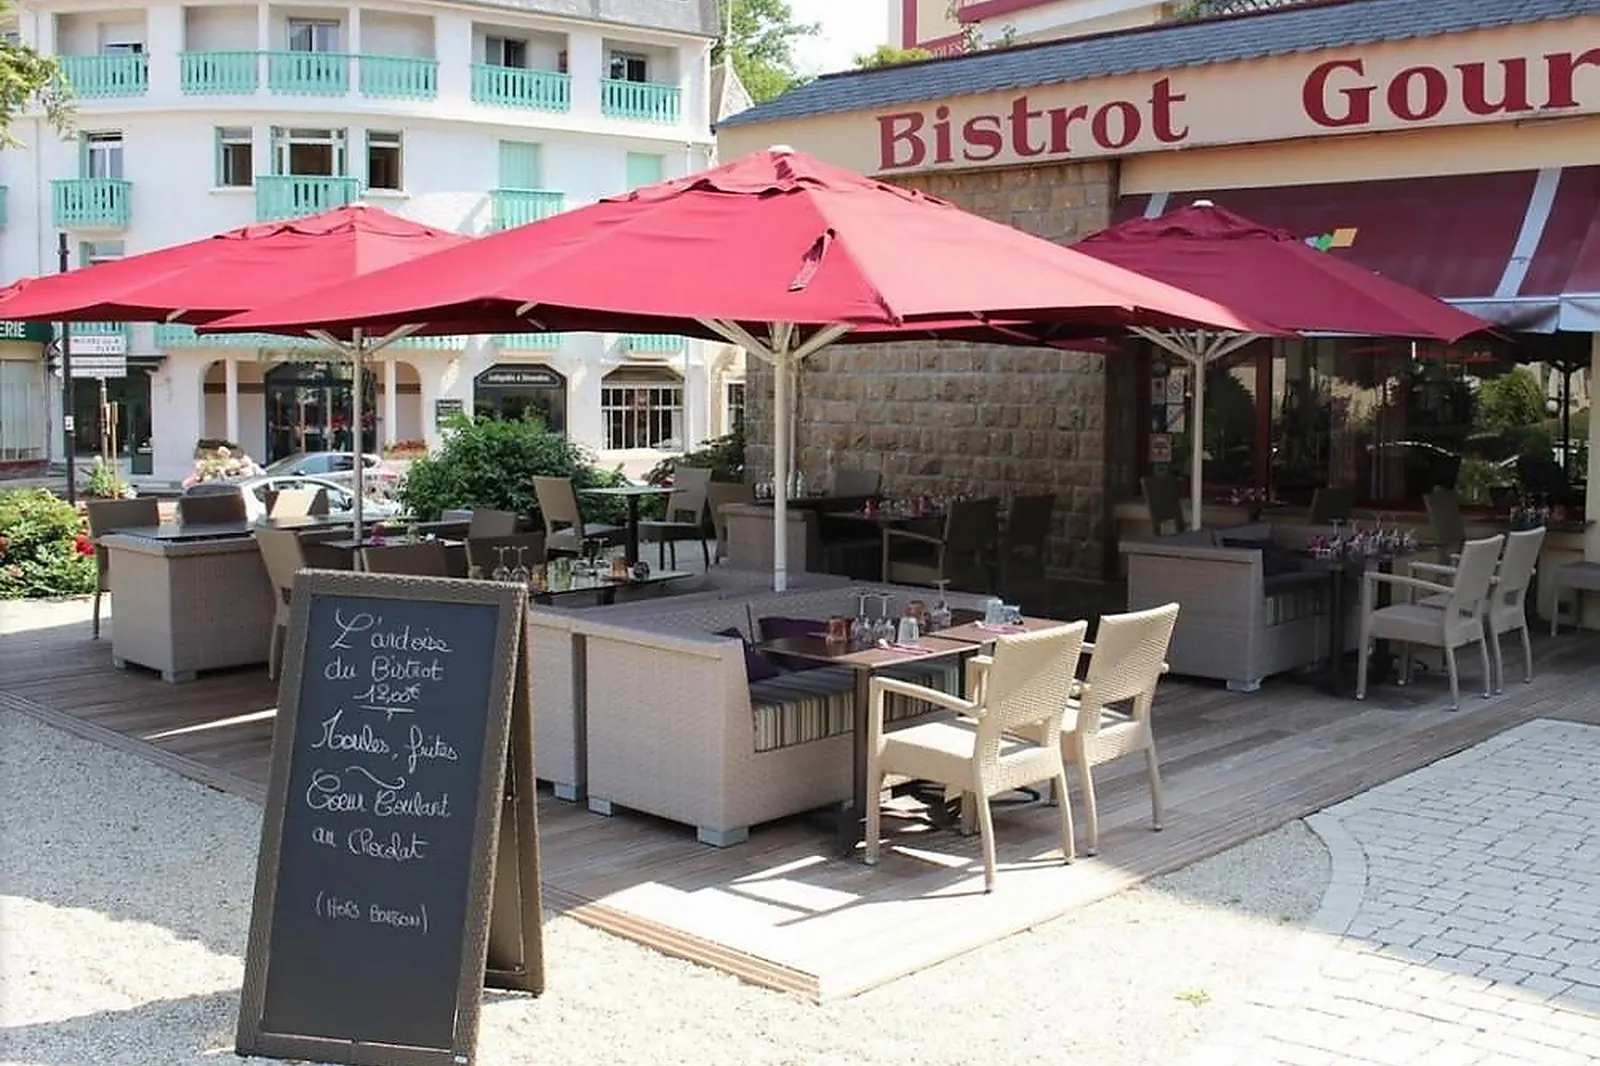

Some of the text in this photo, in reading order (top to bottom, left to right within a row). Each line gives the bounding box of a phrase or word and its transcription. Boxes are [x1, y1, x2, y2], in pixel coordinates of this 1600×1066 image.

[877, 47, 1600, 171] Bistrot Gour
[324, 655, 444, 682] du Bistrot
[312, 827, 336, 848] au
